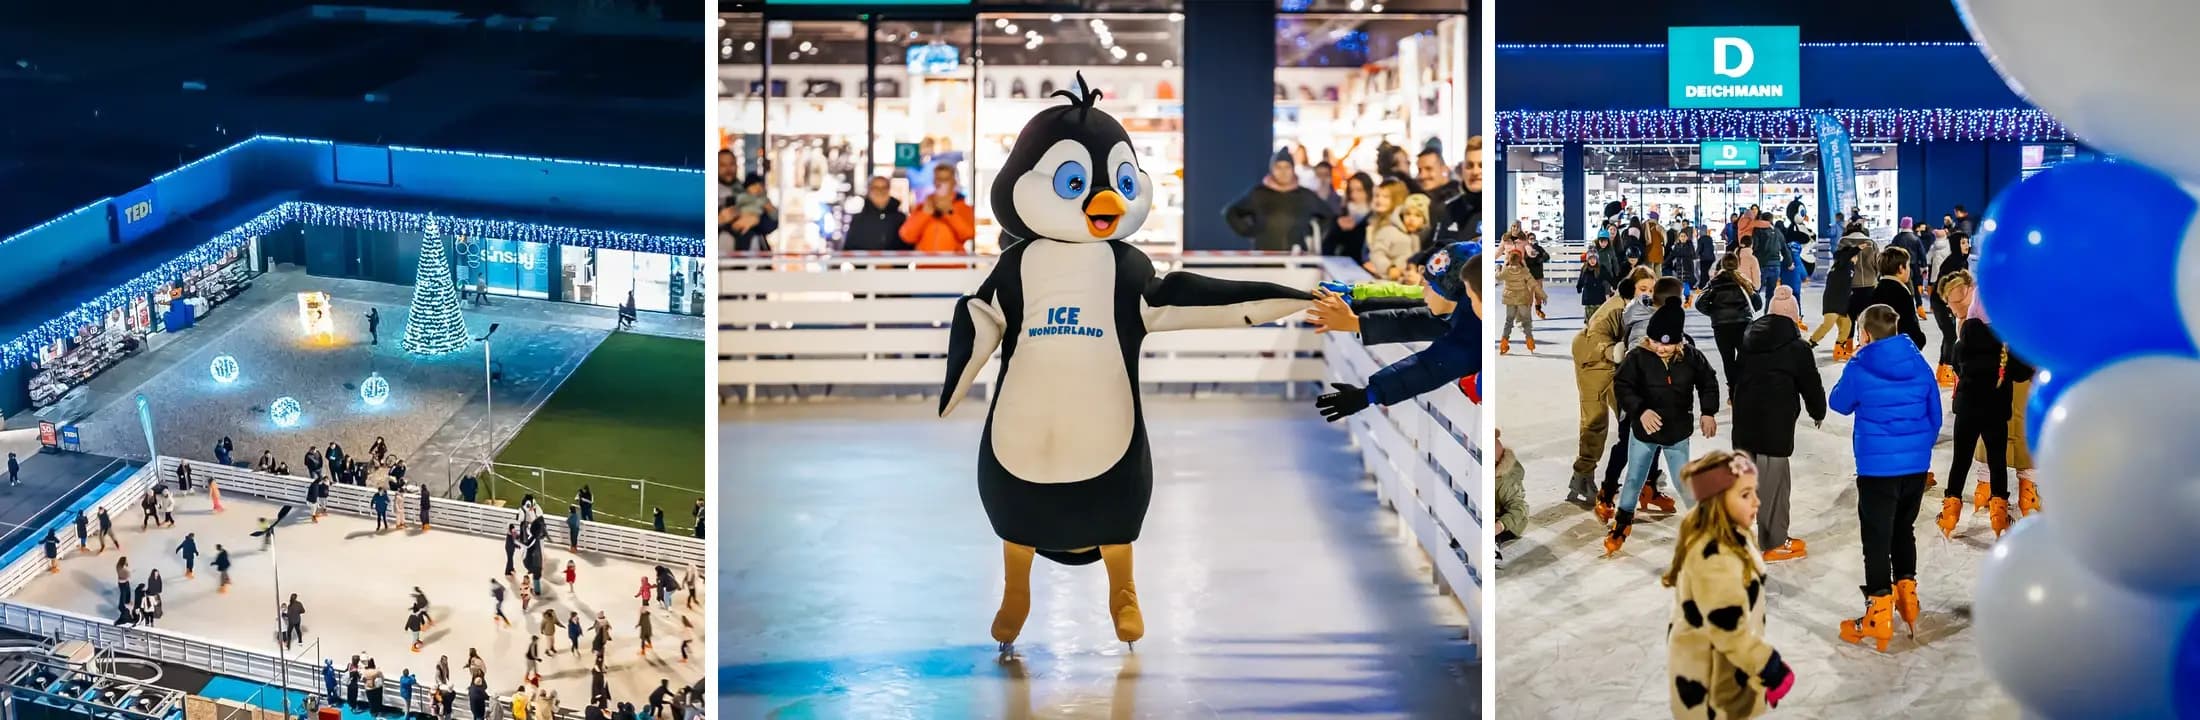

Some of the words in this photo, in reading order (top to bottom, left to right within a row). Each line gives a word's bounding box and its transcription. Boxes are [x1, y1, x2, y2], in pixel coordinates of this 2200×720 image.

[1713, 37, 1754, 78] D
[1685, 85, 1783, 98] DEICHMANN
[1722, 144, 1738, 160] D
[125, 199, 152, 224] TEDi
[480, 246, 535, 270] sinsay
[1047, 306, 1081, 325] ICE
[1028, 326, 1104, 338] WONDERLAND
